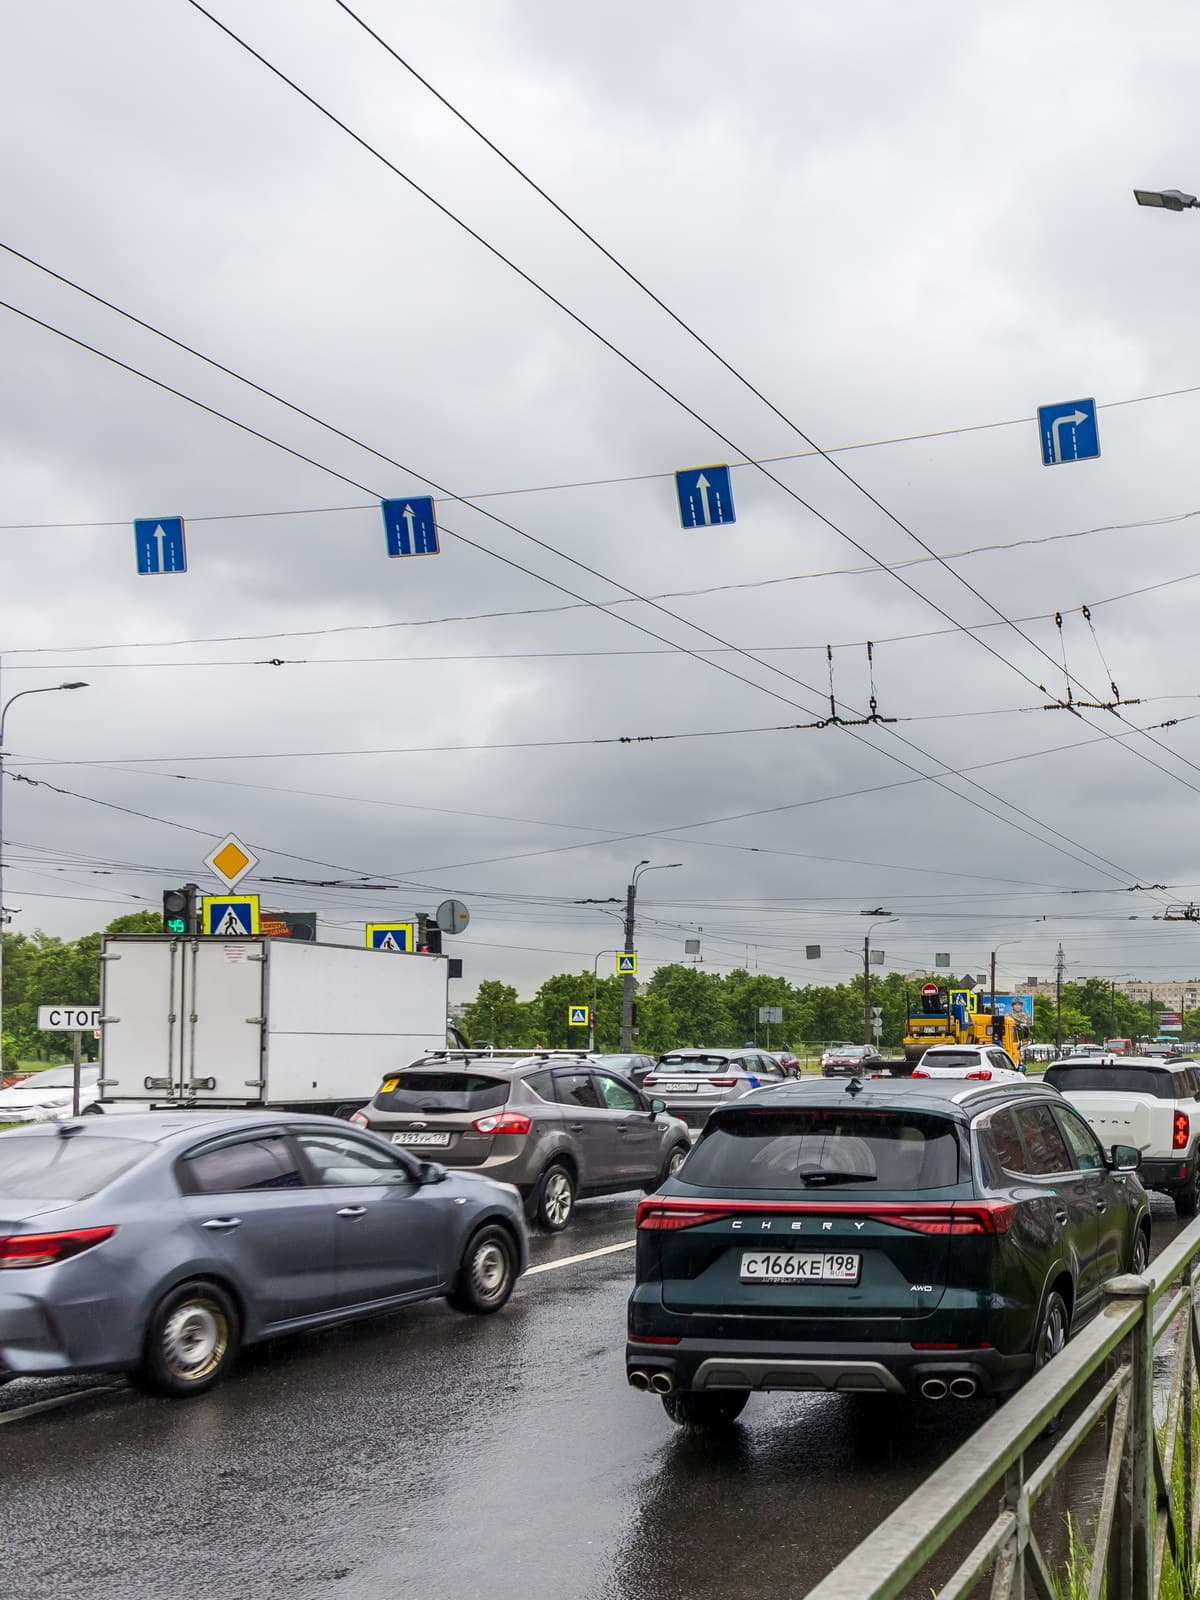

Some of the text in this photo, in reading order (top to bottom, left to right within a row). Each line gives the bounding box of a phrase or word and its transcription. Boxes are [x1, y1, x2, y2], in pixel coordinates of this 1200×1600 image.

[168, 919, 185, 933] 49
[731, 1220, 865, 1231] CHERY
[910, 1284, 933, 1292] AWD
